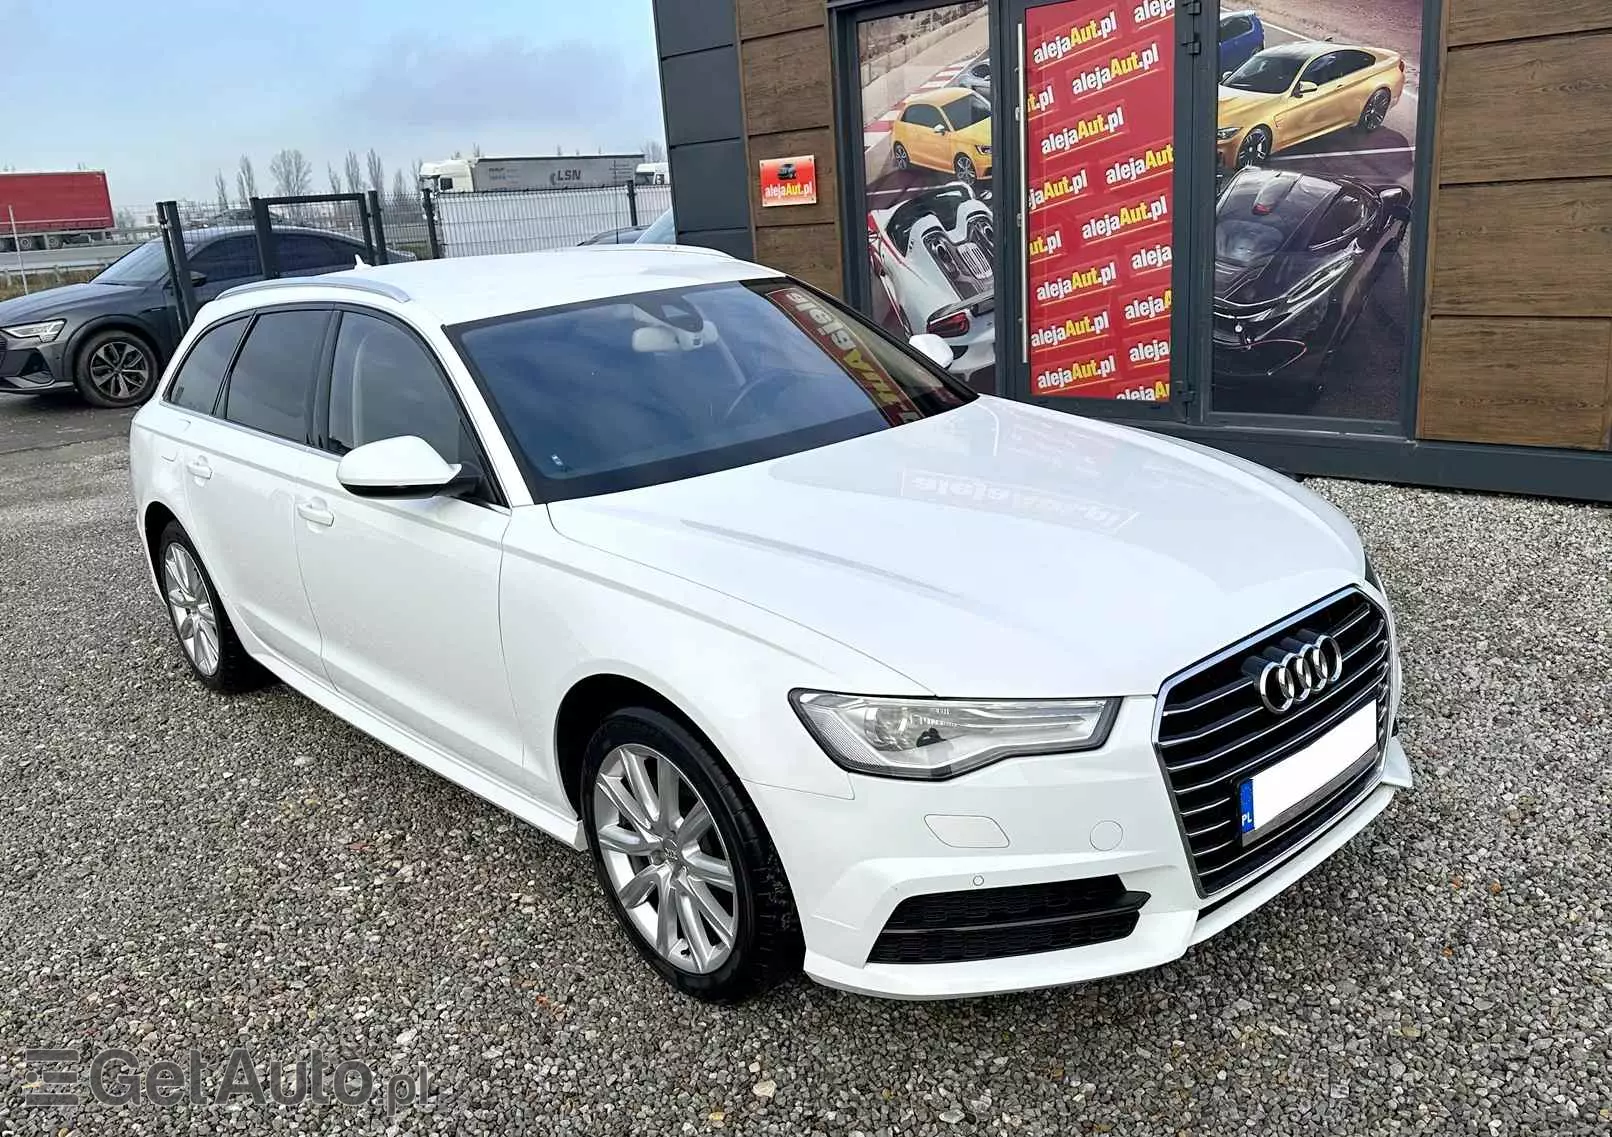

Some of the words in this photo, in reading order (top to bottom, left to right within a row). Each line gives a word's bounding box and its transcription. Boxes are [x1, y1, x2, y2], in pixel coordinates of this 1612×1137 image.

[1033, 11, 1117, 64] alejaAut.pl
[1072, 43, 1159, 95] alejaAut.pl
[1041, 107, 1124, 154] alejaAut.pl
[1106, 144, 1174, 184] alejaAut
[764, 181, 813, 199] alejaAut.pl
[1082, 195, 1168, 240] alejaAut.pl
[1132, 244, 1172, 269] aleja
[1036, 262, 1117, 301] alejaAut.pl
[1030, 311, 1110, 347] alejaAut.pl
[1129, 339, 1169, 362] aleja
[1037, 355, 1116, 388] alejaAut.pl
[1241, 812, 1252, 826] PL
